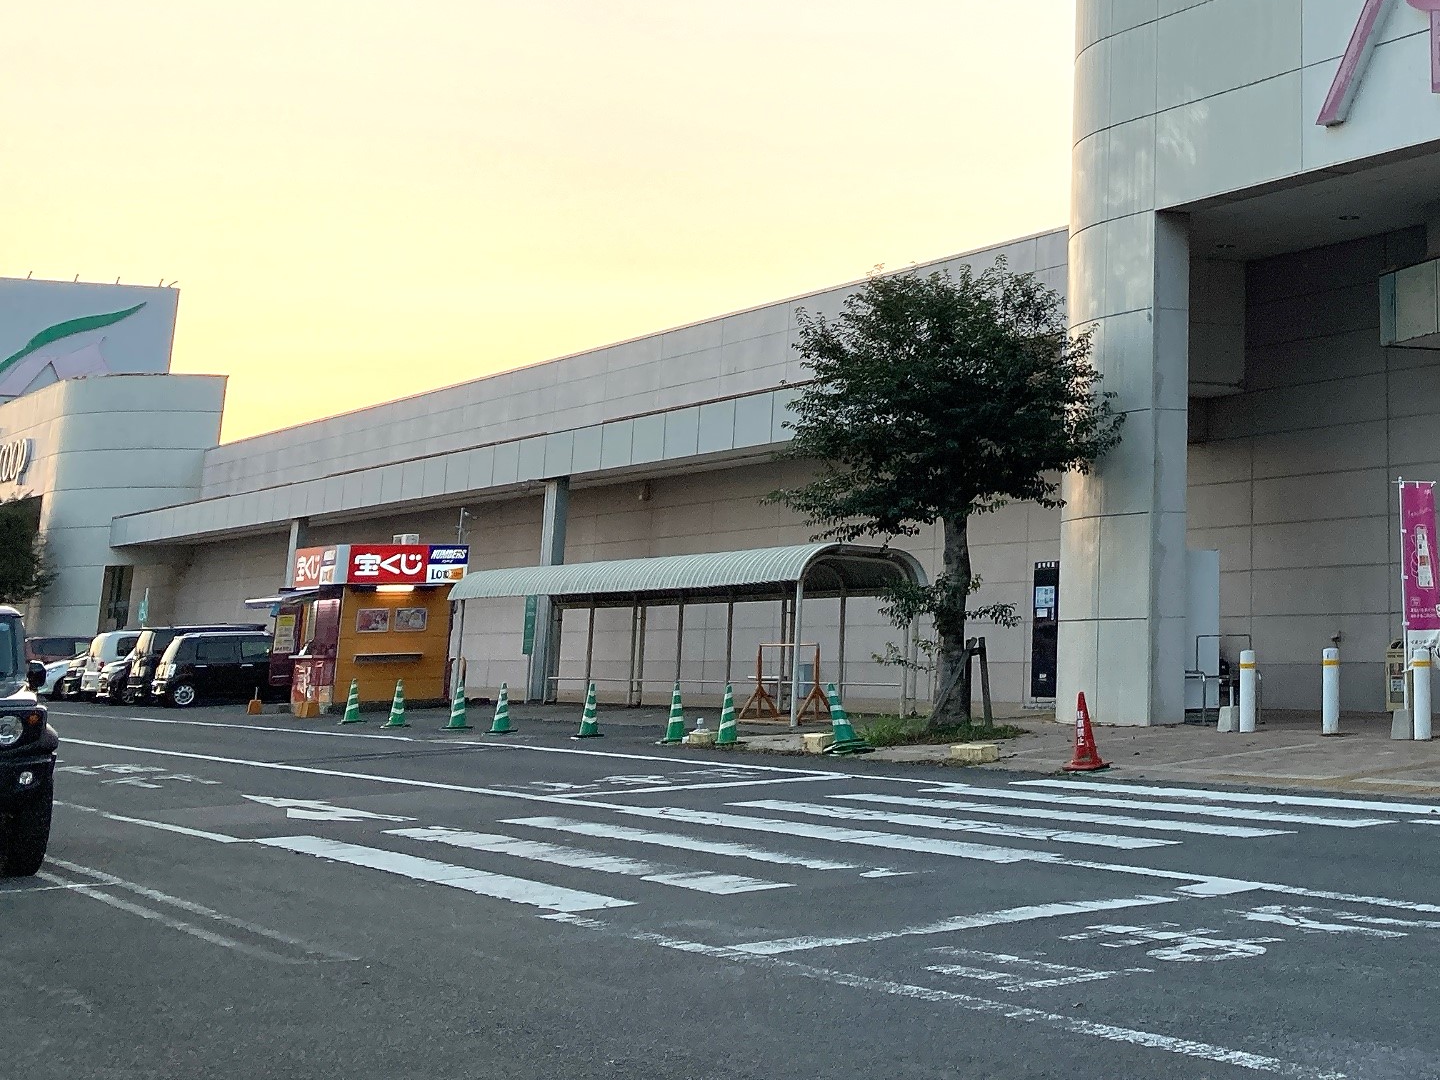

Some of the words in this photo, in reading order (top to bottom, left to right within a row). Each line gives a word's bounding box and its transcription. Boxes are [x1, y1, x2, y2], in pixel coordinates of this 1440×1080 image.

[296, 555, 320, 582] 宝くじ
[353, 553, 423, 577] 宝くじ
